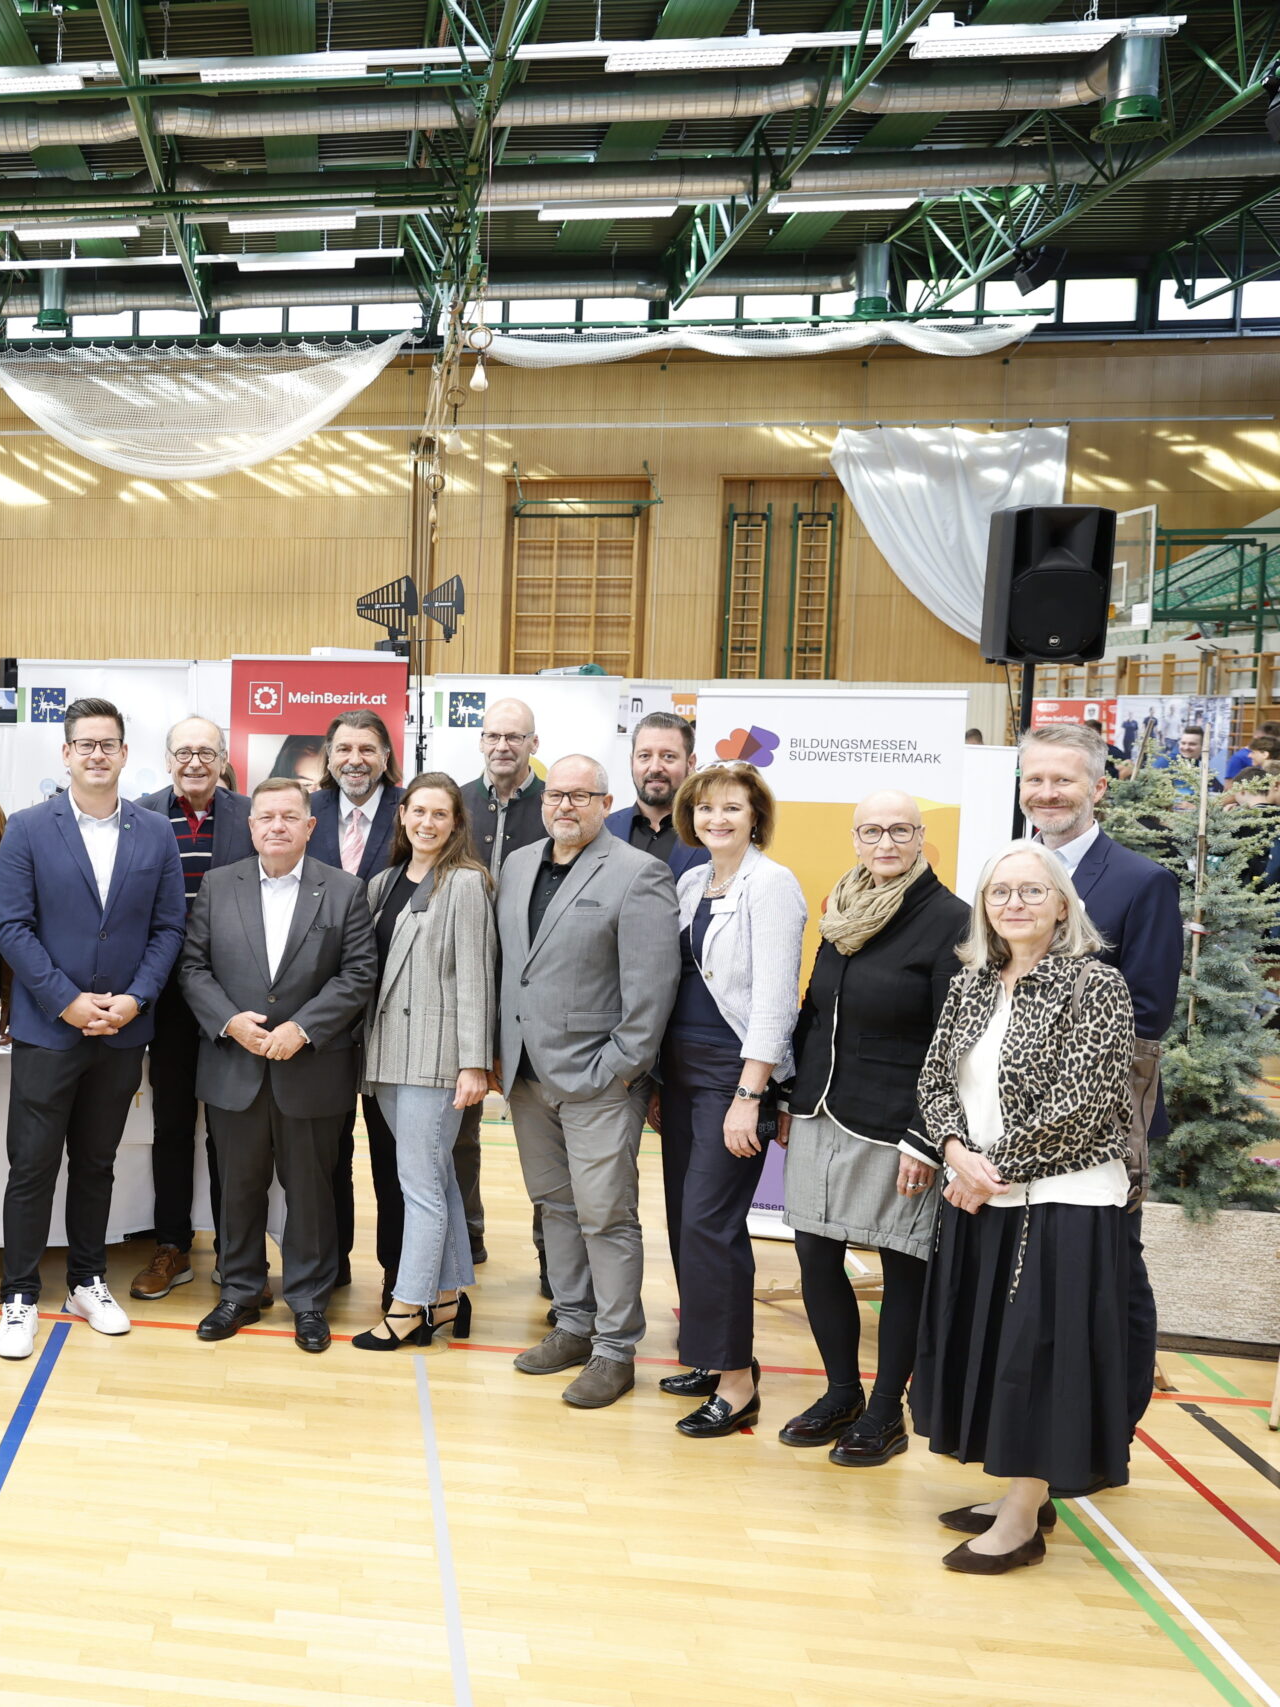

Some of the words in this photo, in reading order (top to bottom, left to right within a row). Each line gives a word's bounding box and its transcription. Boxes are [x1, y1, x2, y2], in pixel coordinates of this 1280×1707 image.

[288, 691, 387, 704] MeinBezirk.at
[790, 737, 918, 751] BILDUNGSMESSEN
[789, 749, 942, 764] SÜDWESTSTEIERMARK
